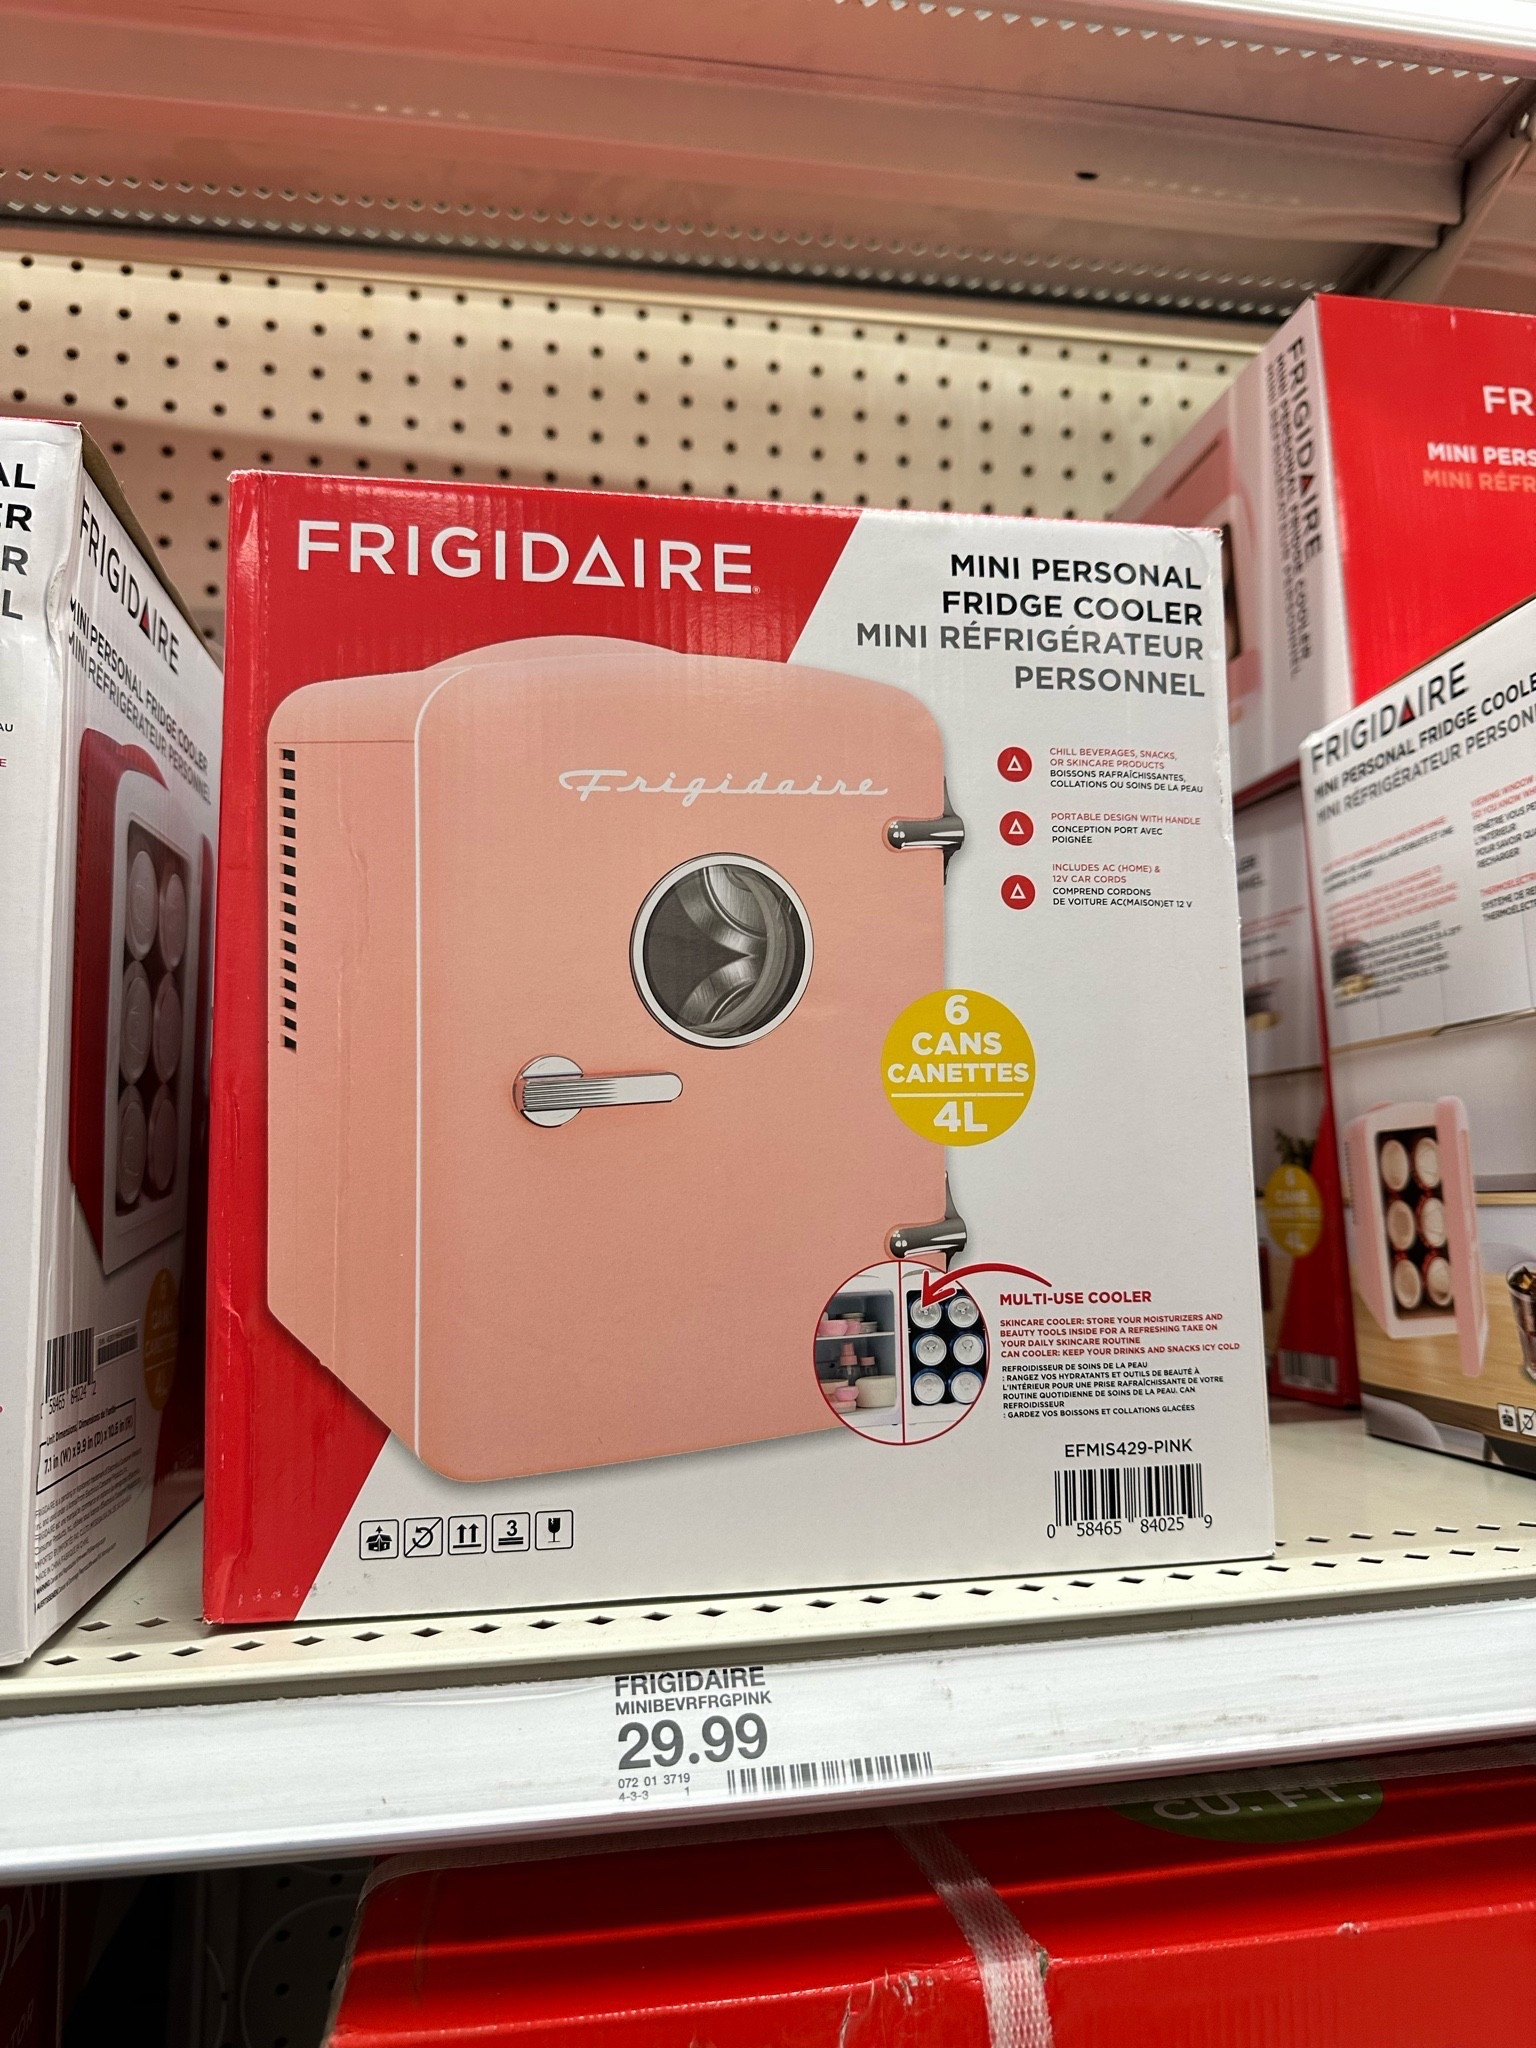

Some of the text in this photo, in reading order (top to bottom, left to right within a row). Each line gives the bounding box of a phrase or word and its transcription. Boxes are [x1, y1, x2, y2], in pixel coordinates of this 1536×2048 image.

[1286, 336, 1323, 562] FRIGIDAIRE
[1427, 441, 1477, 464] MINI
[1423, 469, 1472, 490] MINI
[297, 520, 752, 594] FRIGIDAIRE
[951, 554, 1201, 590] MINI PERSONAL
[80, 495, 180, 677] FRIGIDAIRE
[943, 591, 1202, 626] FRIDGE COOLER
[857, 621, 1203, 660] MINI RÉFRIGÉRATEUR
[1015, 666, 1205, 697] PERSONNEL
[90, 624, 144, 704] PERSONAL
[146, 688, 177, 736] FRIDGE
[178, 727, 208, 777] COOLER
[1311, 661, 1469, 775] FRIGIDAIRE
[88, 656, 167, 758] RÉFRIGÉRATEUR
[168, 743, 212, 806] PERSONNEL
[1050, 748, 1177, 760] CHILL BEVERAGES, SNACKS,
[1342, 740, 1415, 787] PERSONAL
[1419, 706, 1478, 749] FRIDGE
[1067, 759, 1114, 767] SKINCARE
[1117, 761, 1165, 769] PRODUCTS
[1050, 770, 1186, 782] BOISSONS RAFRAÎCHISSANTES,
[1344, 744, 1462, 810] RÉFRIGÉRATEUR
[559, 770, 888, 807] Frigidaire
[1050, 780, 1203, 793] COLLATIONS OU SOINS DE LA PEAU
[1051, 813, 1201, 825] PORTABLE DESIGN WITH HANDLE
[1052, 826, 1163, 835] CONCEPTION PORT AVEC
[1052, 835, 1092, 844] POIGNÉE
[1053, 864, 1160, 873] INCLUDES AC (HOME) &
[1053, 875, 1126, 883] 12V CAR CORDS
[1107, 888, 1151, 896] CORDONS
[1053, 898, 1065, 906] DE
[1068, 898, 1108, 906] VOITURE
[945, 995, 969, 1025] 6
[912, 1032, 1002, 1055] CANS
[888, 1063, 1029, 1083] CANETTES
[933, 1101, 988, 1132] 4L
[1000, 1291, 1152, 1305] MULTI-USE COOLER
[1000, 1318, 1044, 1326] SKINCARE
[1047, 1317, 1084, 1325] COOLER:
[1117, 1316, 1141, 1324] YOUR
[1143, 1314, 1203, 1323] MOISTURIZERS
[1205, 1313, 1223, 1321] AND
[1000, 1329, 1035, 1337] BEAUTY
[1038, 1328, 1067, 1336] TOOLS
[1069, 1327, 1097, 1335] INSIDE
[1120, 1326, 1126, 1334] A
[1129, 1325, 1180, 1333] REFRESHING
[1182, 1324, 1203, 1332] TAKE
[1001, 1350, 1020, 1358] CAN
[1022, 1349, 1060, 1357] COOLER:
[1063, 1348, 1084, 1356] KEEP
[1087, 1347, 1111, 1356] YOUR
[1114, 1347, 1145, 1355] DRINKS
[1148, 1346, 1165, 1354] AND
[1167, 1344, 1200, 1353] SNACKS
[1218, 1343, 1240, 1351] COLD
[1028, 1339, 1054, 1347] DAILY
[1056, 1338, 1100, 1346] SKINCARE
[1103, 1337, 1140, 1345] ROUTINE
[1002, 1364, 1063, 1372] REFROIDISSEUR
[1065, 1363, 1076, 1371] DE
[1103, 1362, 1113, 1370] DE
[1128, 1361, 1148, 1369] PEAU
[1007, 1373, 1038, 1382] RANGEZ
[1059, 1372, 1110, 1380] HYDRATANTS
[1123, 1370, 1150, 1378] OUTILS
[1164, 1368, 1192, 1376] BEAUTÉ
[1076, 1381, 1092, 1389] UNE
[1094, 1380, 1115, 1388] PRISE
[1118, 1378, 1185, 1387] RAFRAÎCHISSANTE
[1188, 1377, 1198, 1385] DE
[1200, 1376, 1223, 1384] VOTRE
[1003, 1392, 1037, 1400] ROUTINE
[1040, 1390, 1093, 1399] QUOTIDIENNE
[1095, 1389, 1106, 1397] DE
[1108, 1389, 1131, 1397] SOINS
[1157, 1387, 1177, 1395] PEAU.
[1179, 1386, 1195, 1394] CAN
[1003, 1401, 1064, 1409] REFROIDISSEUR
[1008, 1410, 1040, 1419] GARDEZ
[1042, 1409, 1058, 1417] VOS
[1113, 1406, 1160, 1415] COLLATIONS
[1162, 1404, 1195, 1412] GLACÉES
[53, 1455, 59, 1467] in
[60, 1449, 72, 1468] (W)
[77, 1439, 86, 1458] 9.9
[87, 1435, 94, 1447] in
[94, 1429, 104, 1446] (D)
[1065, 1439, 1192, 1457] EFMIS429-PINK
[506, 1520, 518, 1536] 3
[1047, 1515, 1213, 1538] 0 58465 84025 9
[615, 1666, 766, 1697] FRIGIDAIRE
[615, 1691, 772, 1715] MINIBEVRFRGPINK
[618, 1713, 768, 1770] 29.99
[618, 1773, 690, 1789] 072 01 3719
[619, 1787, 690, 1802] 4-3-3 1
